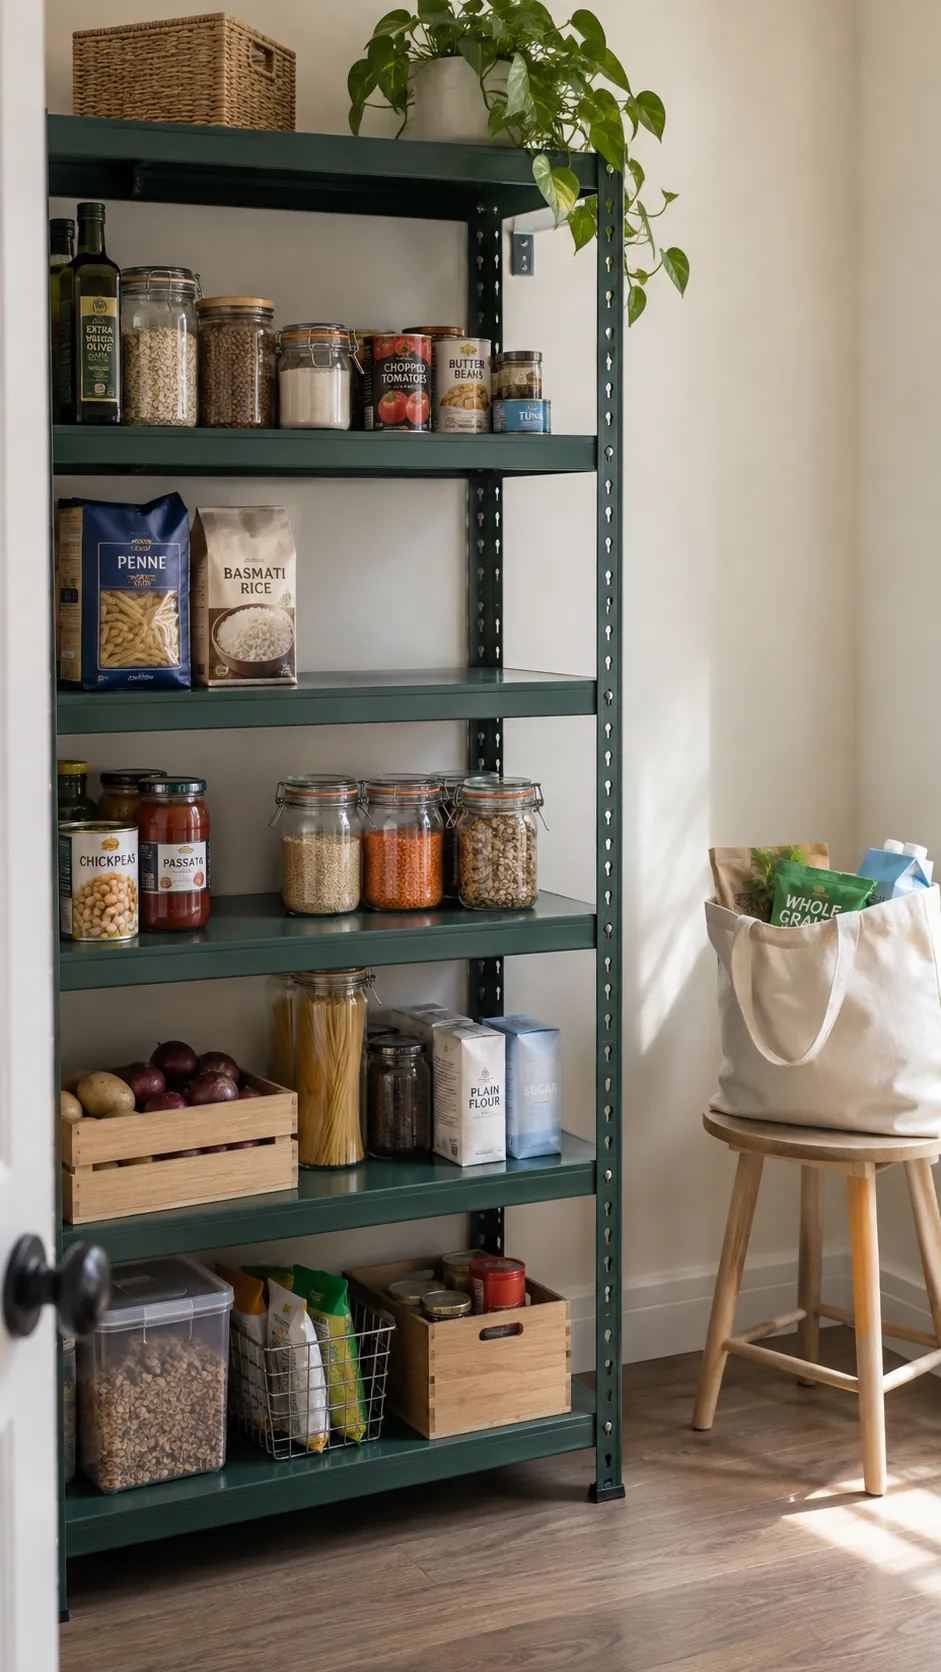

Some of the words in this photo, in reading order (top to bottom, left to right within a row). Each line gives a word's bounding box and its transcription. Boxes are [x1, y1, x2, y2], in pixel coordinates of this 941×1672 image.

[86, 325, 113, 334] EXTRA
[86, 343, 112, 352] OLIVE
[449, 359, 485, 369] BUTTER
[381, 373, 427, 384] TOMATOES
[454, 369, 483, 380] BEANS
[117, 555, 167, 569] PENNE
[224, 567, 285, 579] BASMATI
[240, 582, 272, 594] RICE
[79, 852, 136, 867] CHICKPEAS
[163, 857, 204, 868] PASSATA
[786, 894, 842, 917] WHOLE
[470, 1085, 500, 1098] PLAIN
[523, 1082, 558, 1096] SUGAR
[469, 1096, 500, 1109] FLOUR
